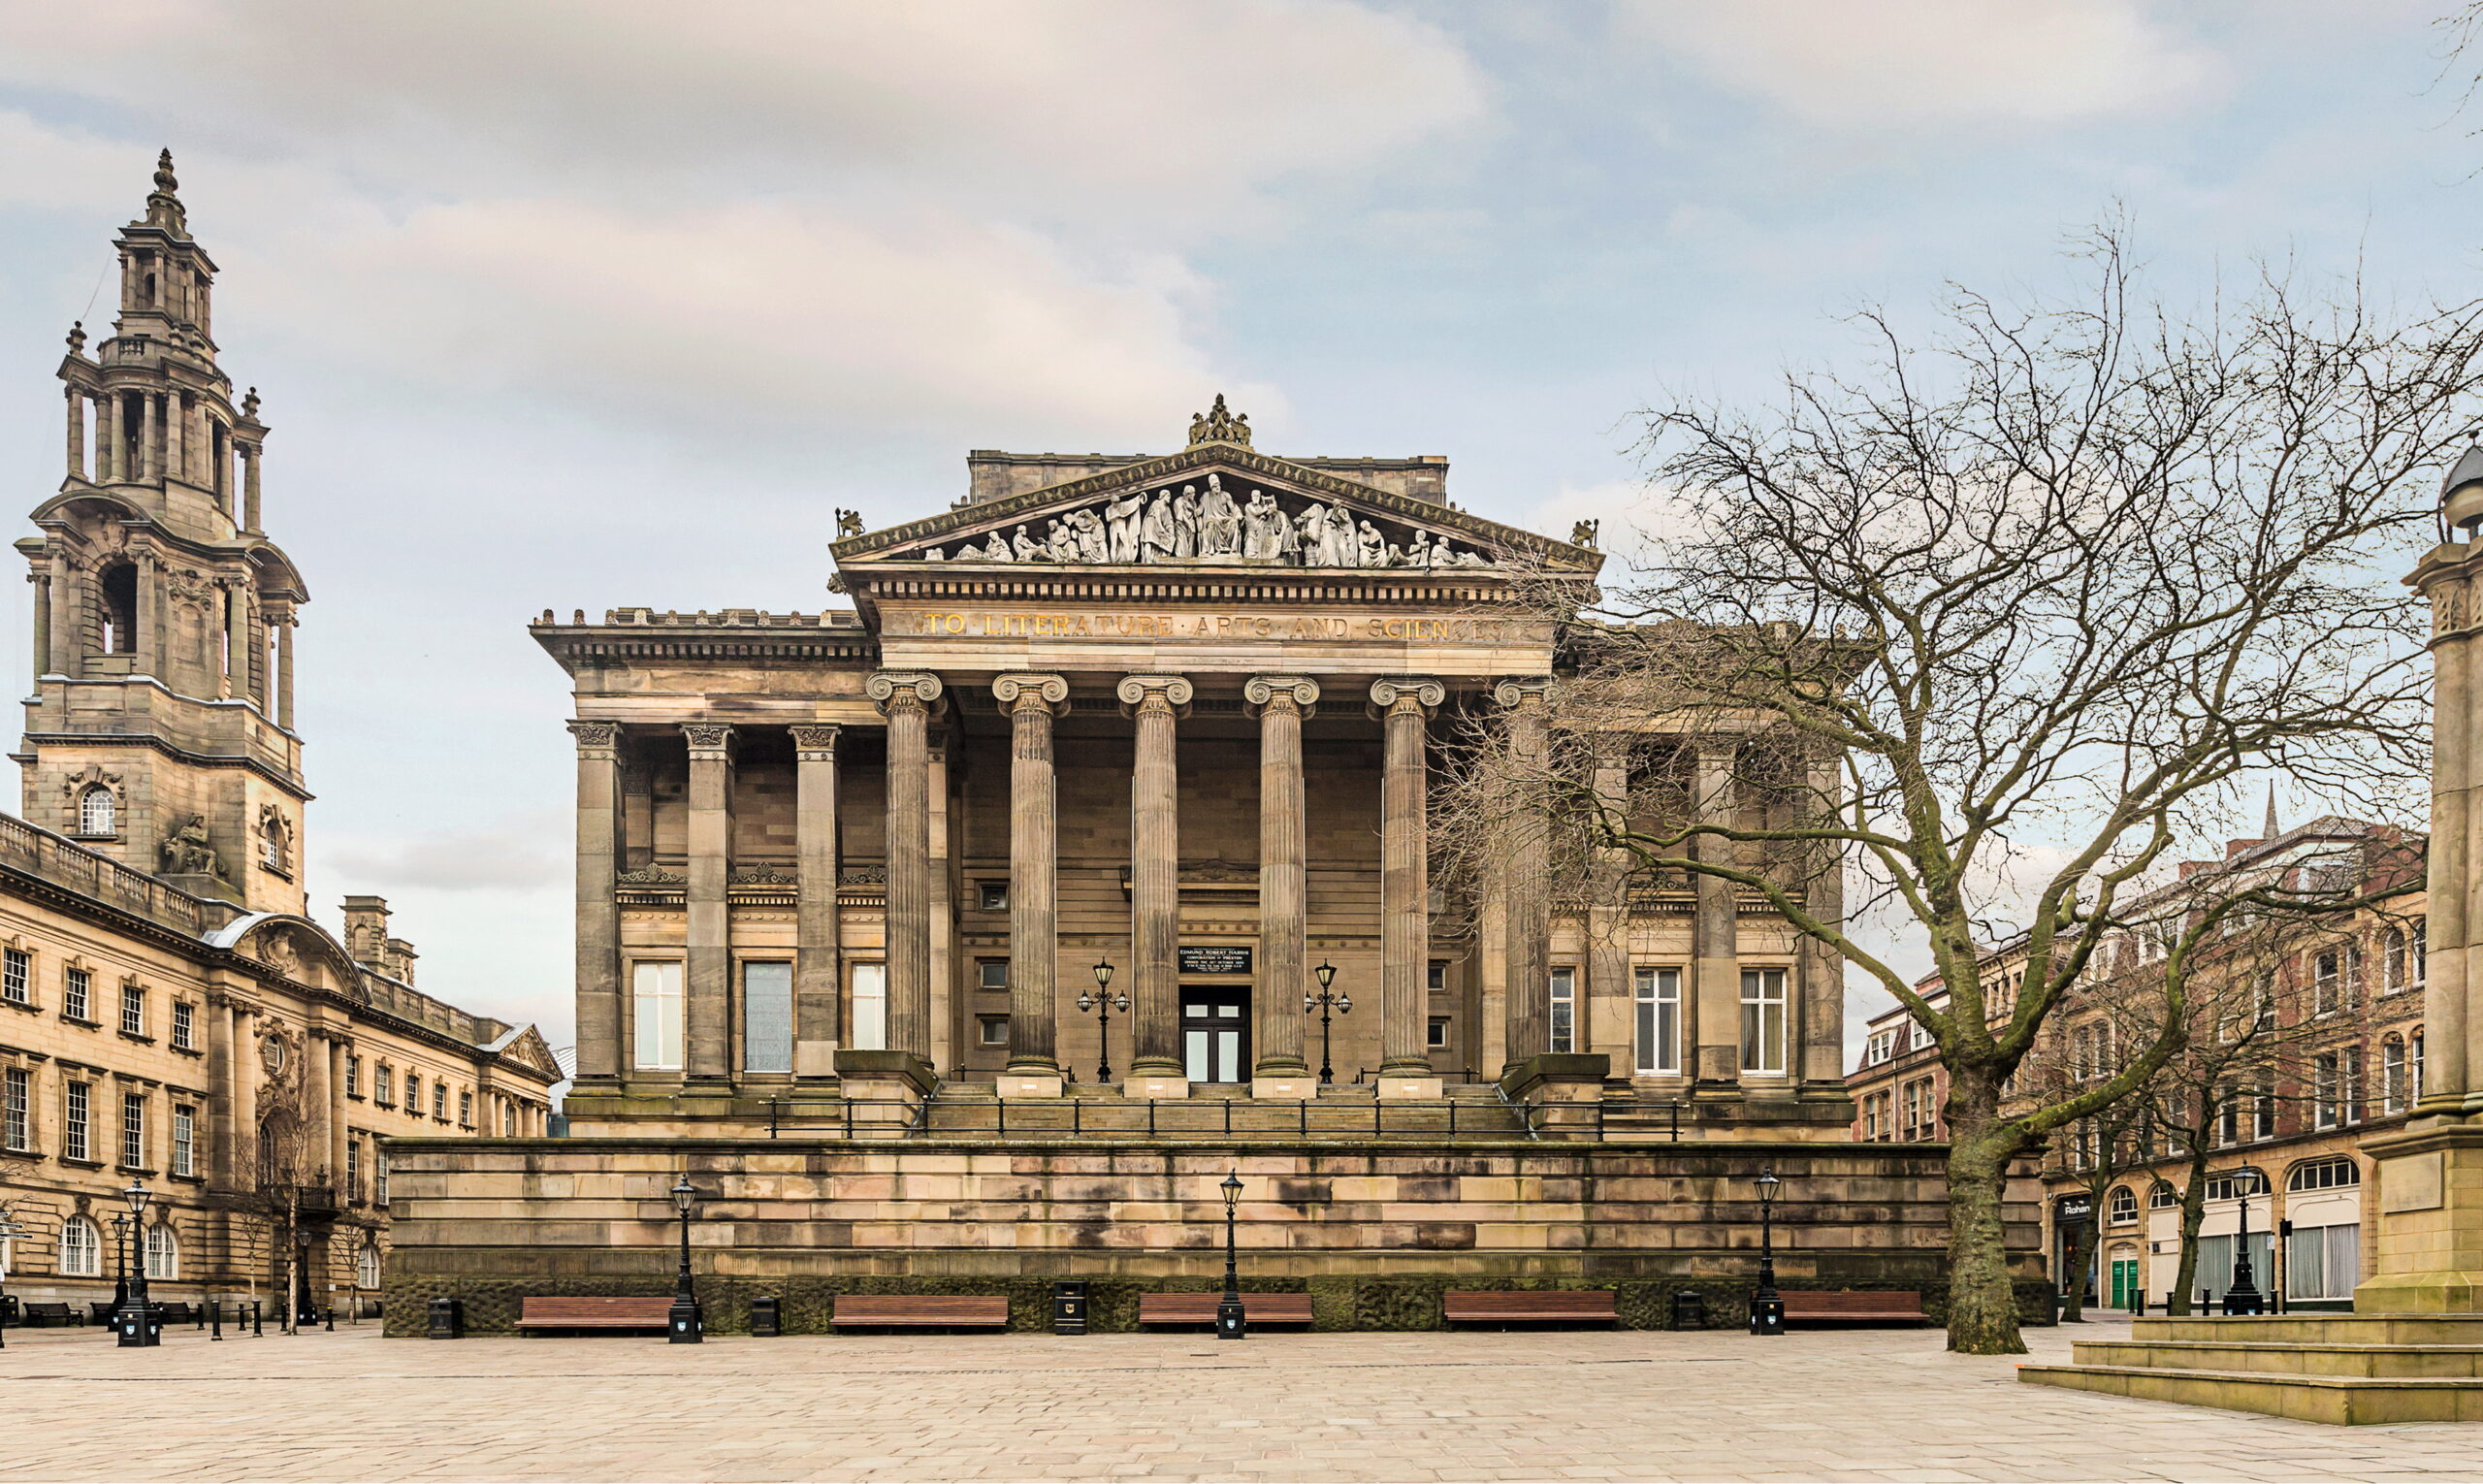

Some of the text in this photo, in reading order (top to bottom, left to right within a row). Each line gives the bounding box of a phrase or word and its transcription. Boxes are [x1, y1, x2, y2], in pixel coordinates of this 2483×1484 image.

[924, 614, 1504, 639] TO LITERATURE ARTS AND SCIENCES
[2065, 1205, 2090, 1214] Rohan
